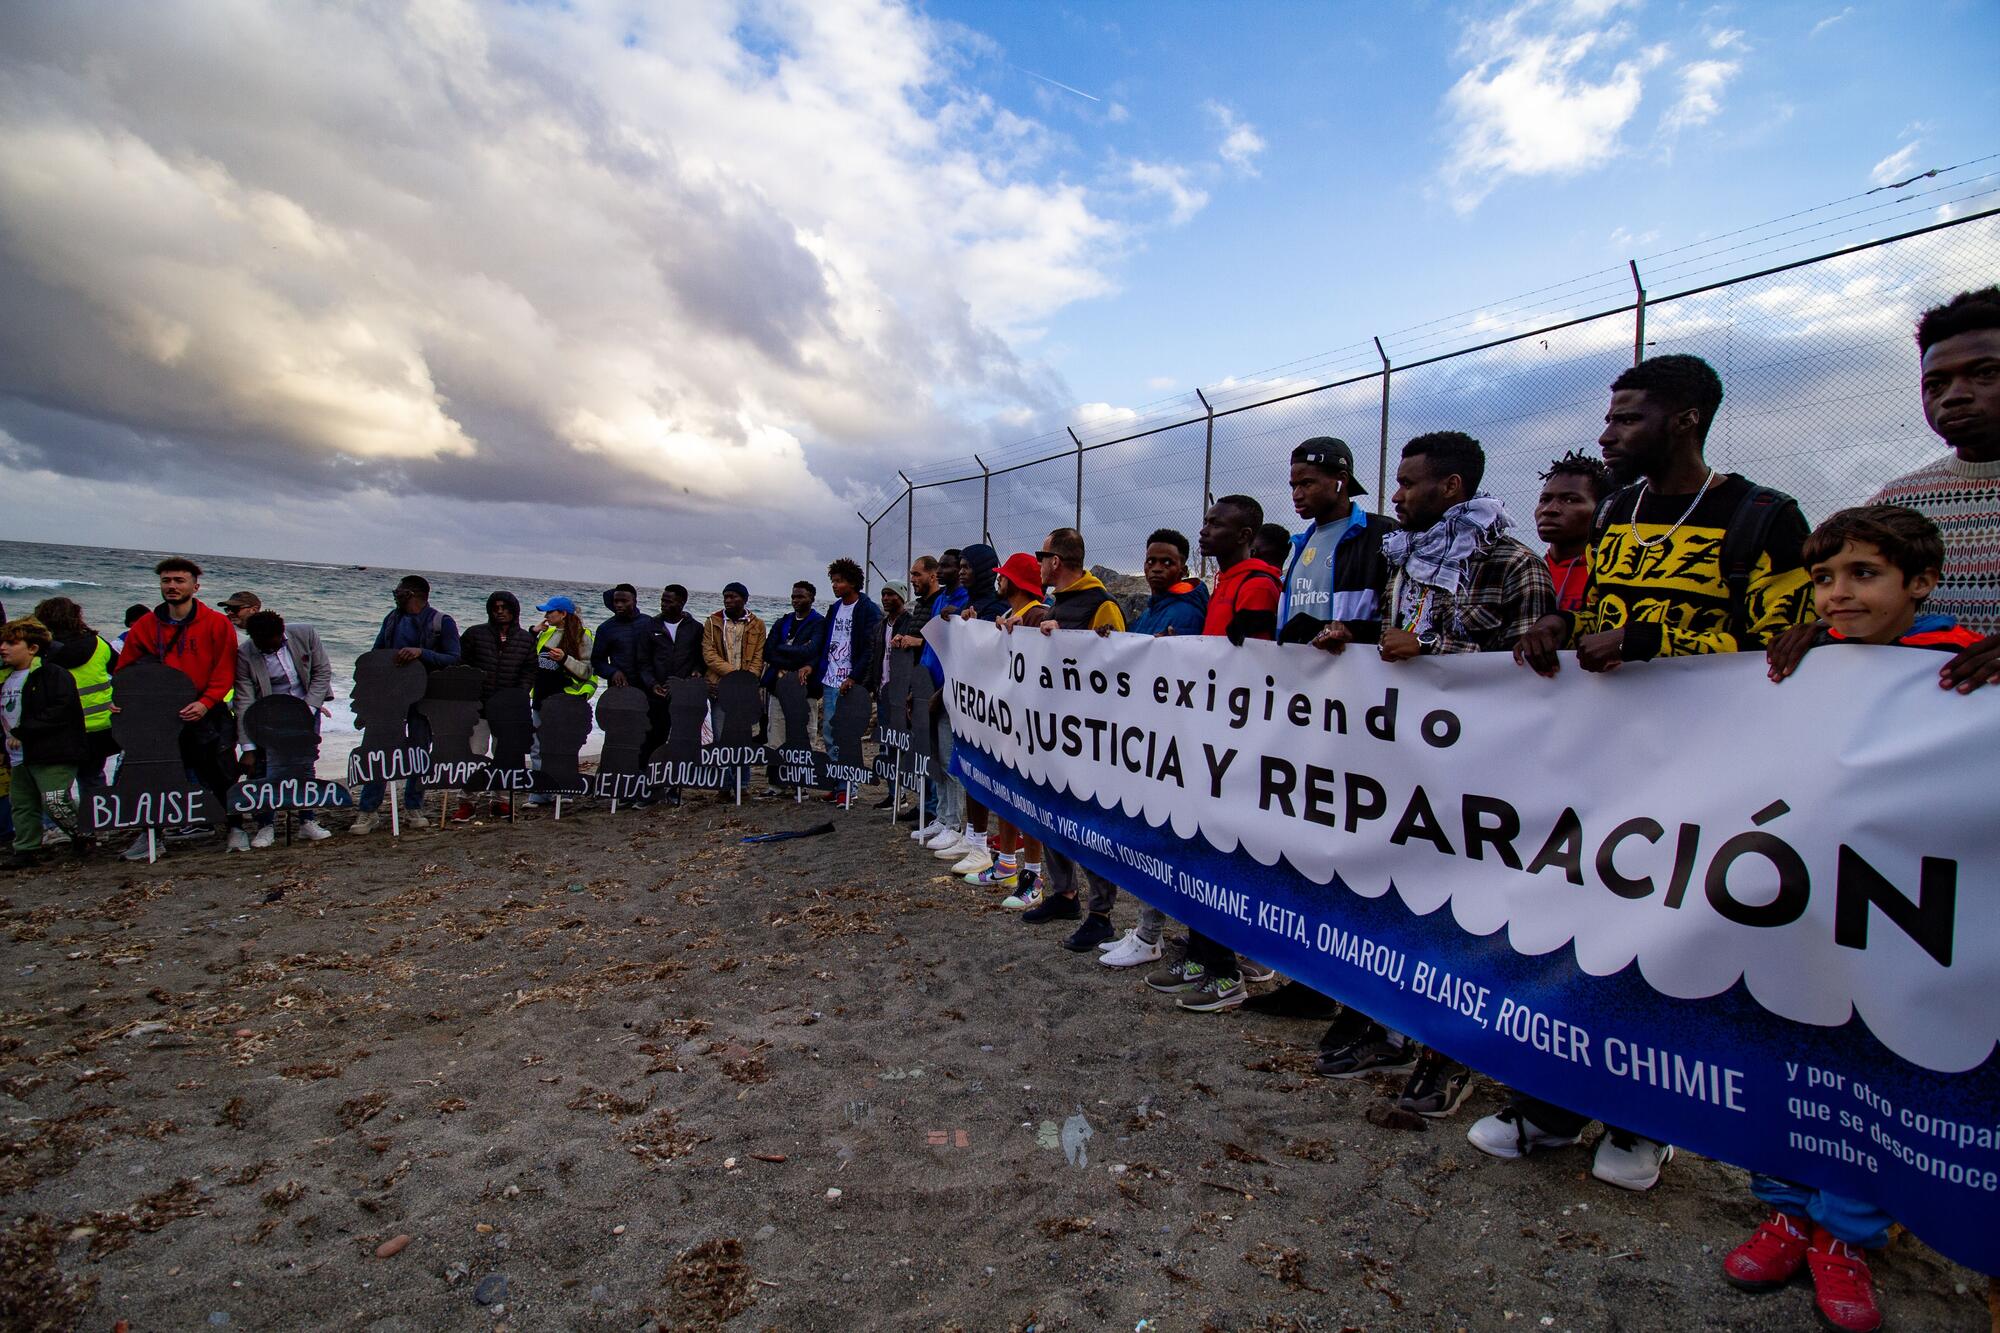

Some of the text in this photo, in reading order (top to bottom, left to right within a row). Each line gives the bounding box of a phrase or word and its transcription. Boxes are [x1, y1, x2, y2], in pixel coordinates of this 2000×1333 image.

[1296, 577, 1312, 591] Fly
[1039, 657, 1131, 698] años
[1152, 668, 1462, 749] exigiendo
[880, 726, 910, 751] LARIOS
[701, 746, 769, 766] DAOUDA
[914, 752, 931, 777] LUC
[484, 767, 535, 791] YVES
[778, 764, 819, 786] CHIMIE
[825, 763, 874, 785] YOUSSOUF
[92, 789, 207, 829] BLAISE
[234, 778, 344, 812] SAMBA
[951, 677, 1958, 968] VERDAD, JUSTICIA Y REPARACIÓN
[1057, 816, 1081, 846] YVES,
[1081, 826, 1119, 863] LARIOS,
[1116, 842, 1177, 893] YOUSSOUF,
[1179, 871, 1252, 926] OUSMANE,
[1258, 900, 1311, 949] KEITA,
[1317, 923, 1406, 991] OMAROU,
[1412, 960, 1490, 1029] BLAISE,
[1495, 997, 1592, 1068] ROGER
[1604, 1037, 1747, 1113] CHIMIE
[1786, 1061, 1799, 1082] y
[1808, 1066, 1846, 1091] por
[1853, 1082, 1892, 1118] otro
[1788, 1097, 1998, 1192] que se desconoce
[1789, 1131, 1879, 1174] nombre
